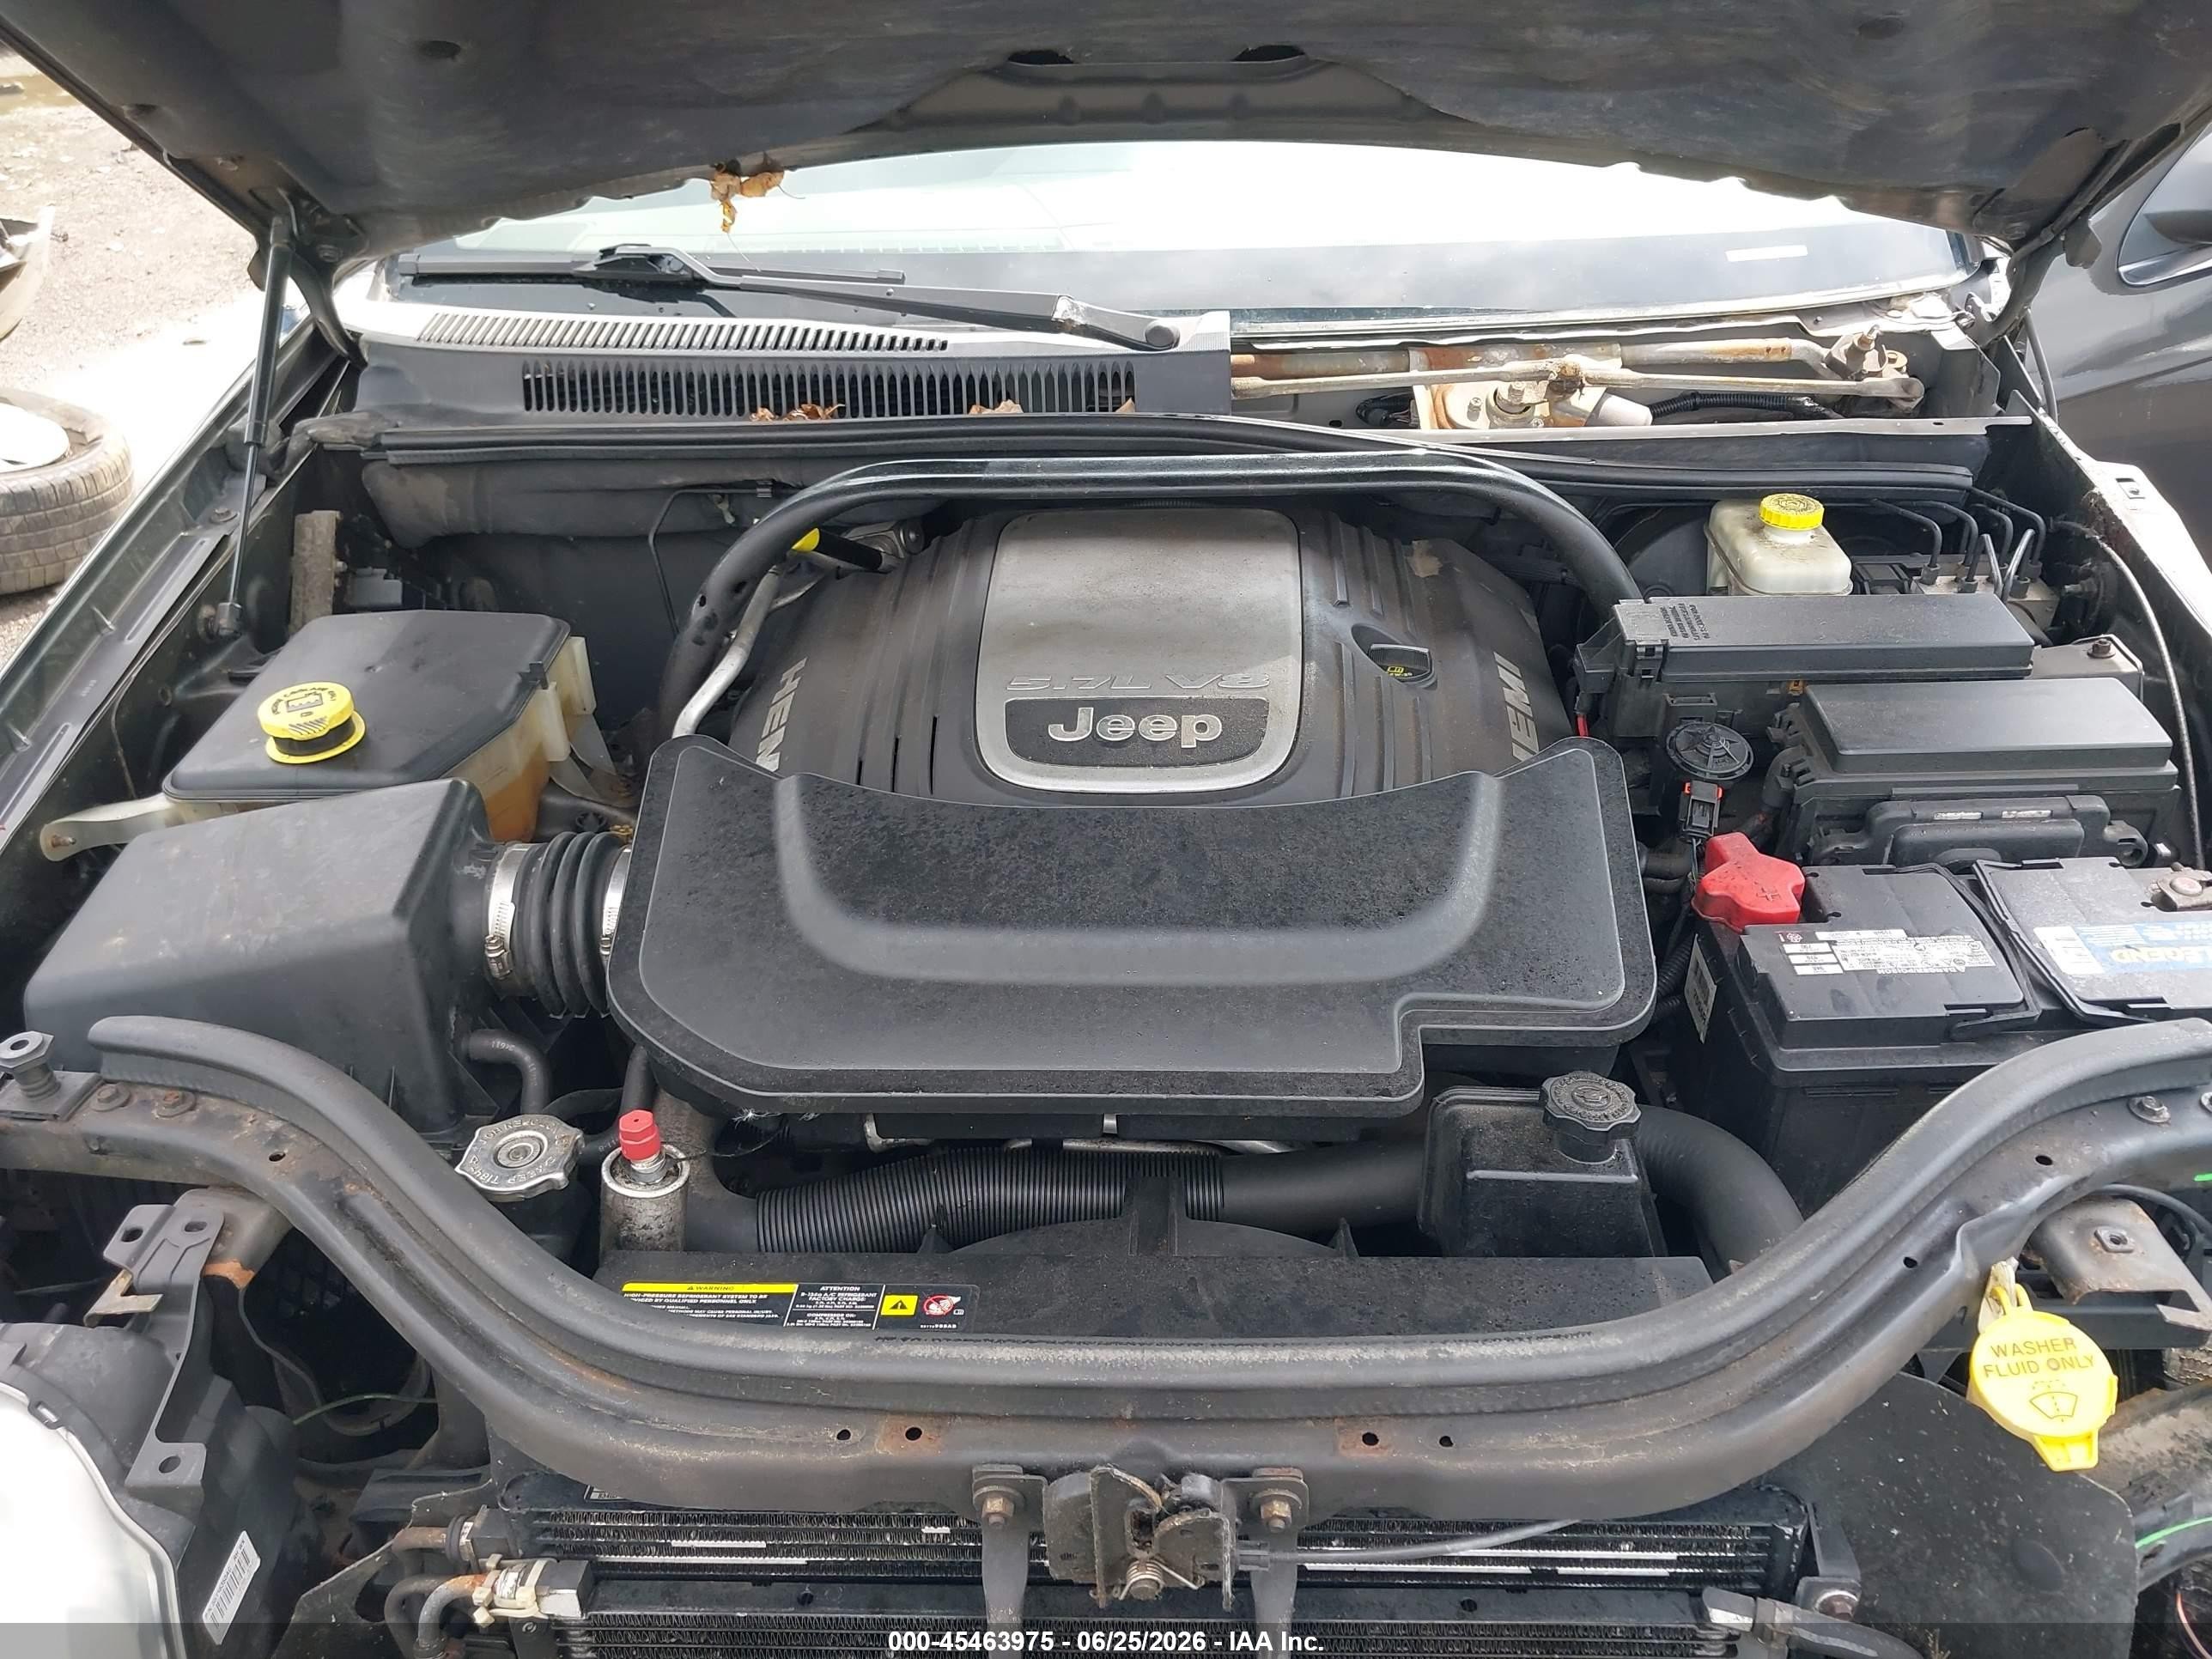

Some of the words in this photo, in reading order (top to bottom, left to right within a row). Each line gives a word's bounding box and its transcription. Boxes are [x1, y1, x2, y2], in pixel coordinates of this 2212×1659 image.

[1006, 673, 1152, 691] 5.7L
[1166, 672, 1271, 690] V8
[1048, 707, 1223, 749] Jeep
[1990, 1337, 2077, 1358] WASHER
[1983, 1360, 2040, 1378] FLUID
[2046, 1355, 2094, 1371] ONLY
